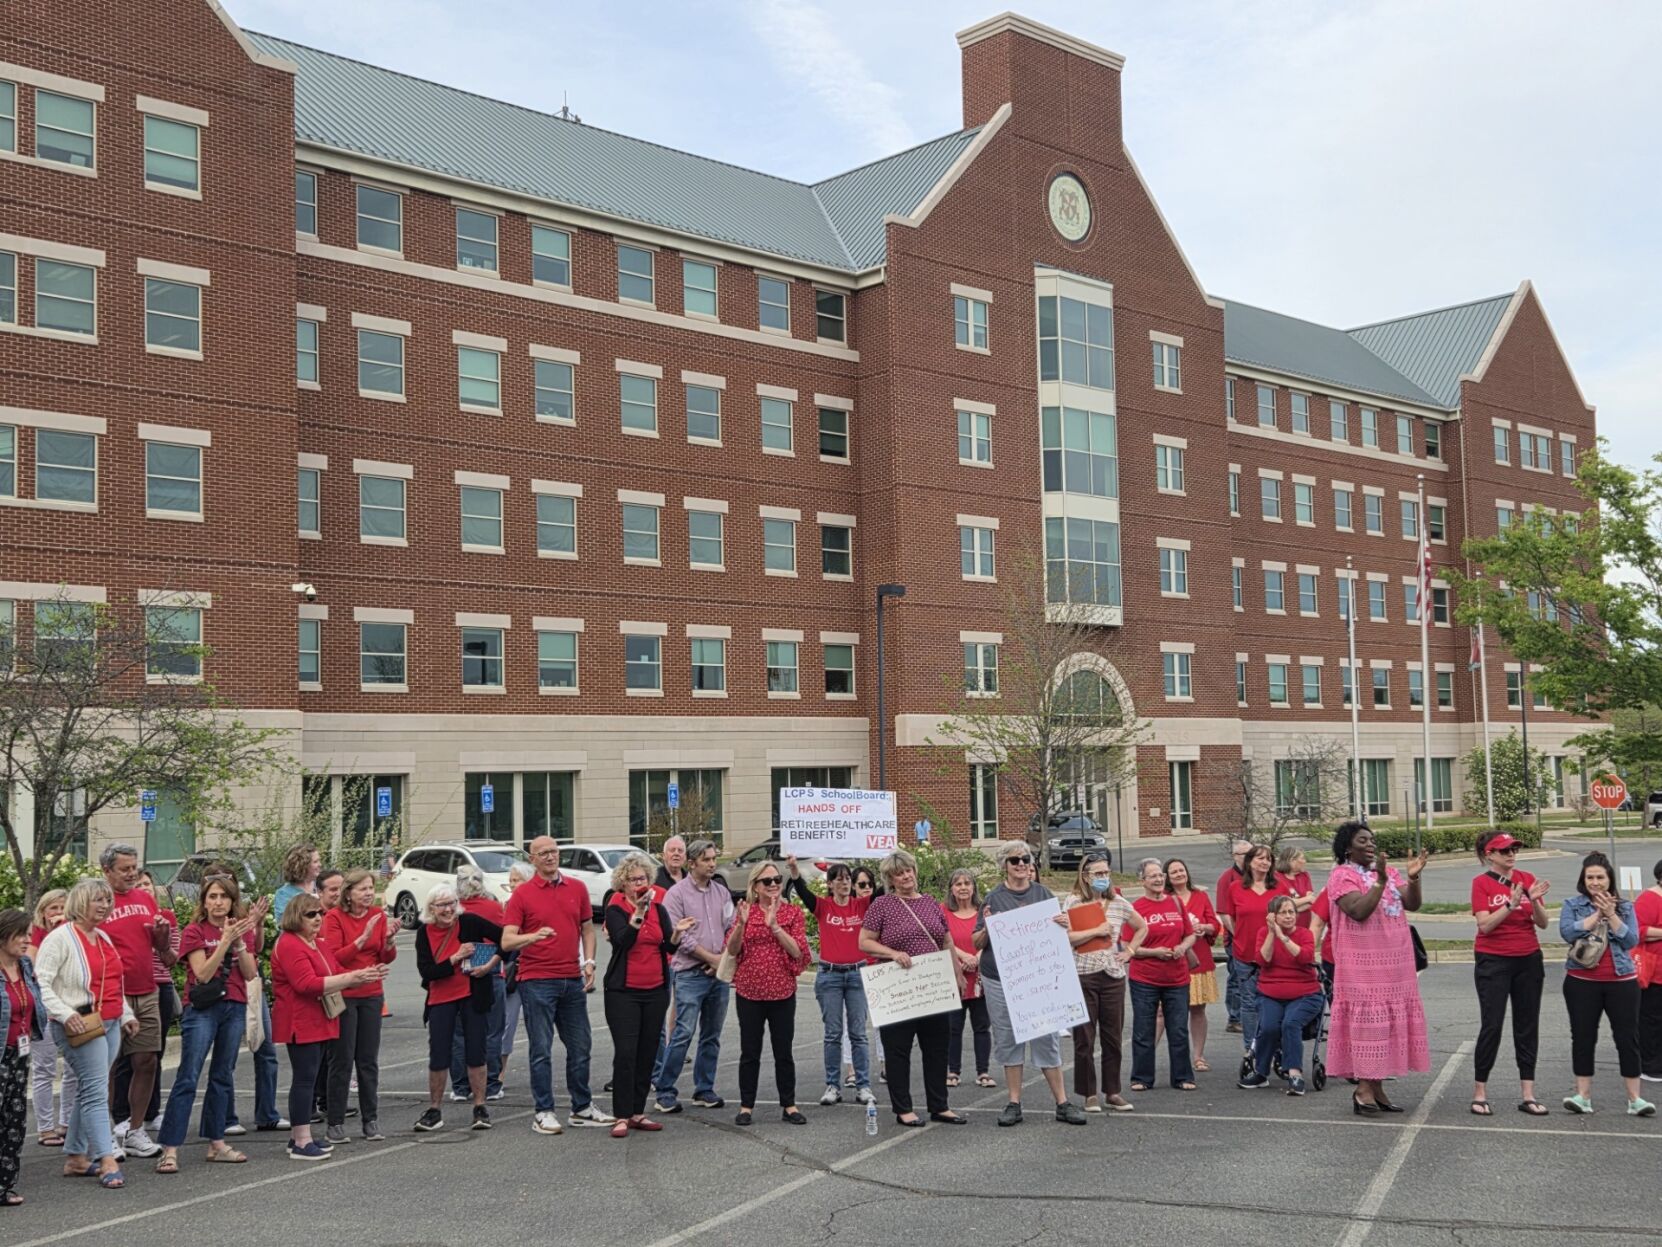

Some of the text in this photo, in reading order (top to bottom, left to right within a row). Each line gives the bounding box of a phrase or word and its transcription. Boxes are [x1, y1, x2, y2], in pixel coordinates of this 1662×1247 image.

[784, 788, 815, 798] LCPS
[1594, 785, 1623, 799] STOP
[798, 803, 862, 814] HANDS OFF
[790, 830, 847, 840] BENEFITS!
[867, 835, 895, 849] VEA
[105, 904, 151, 924] ATLANTA
[991, 917, 1051, 940] Retirees
